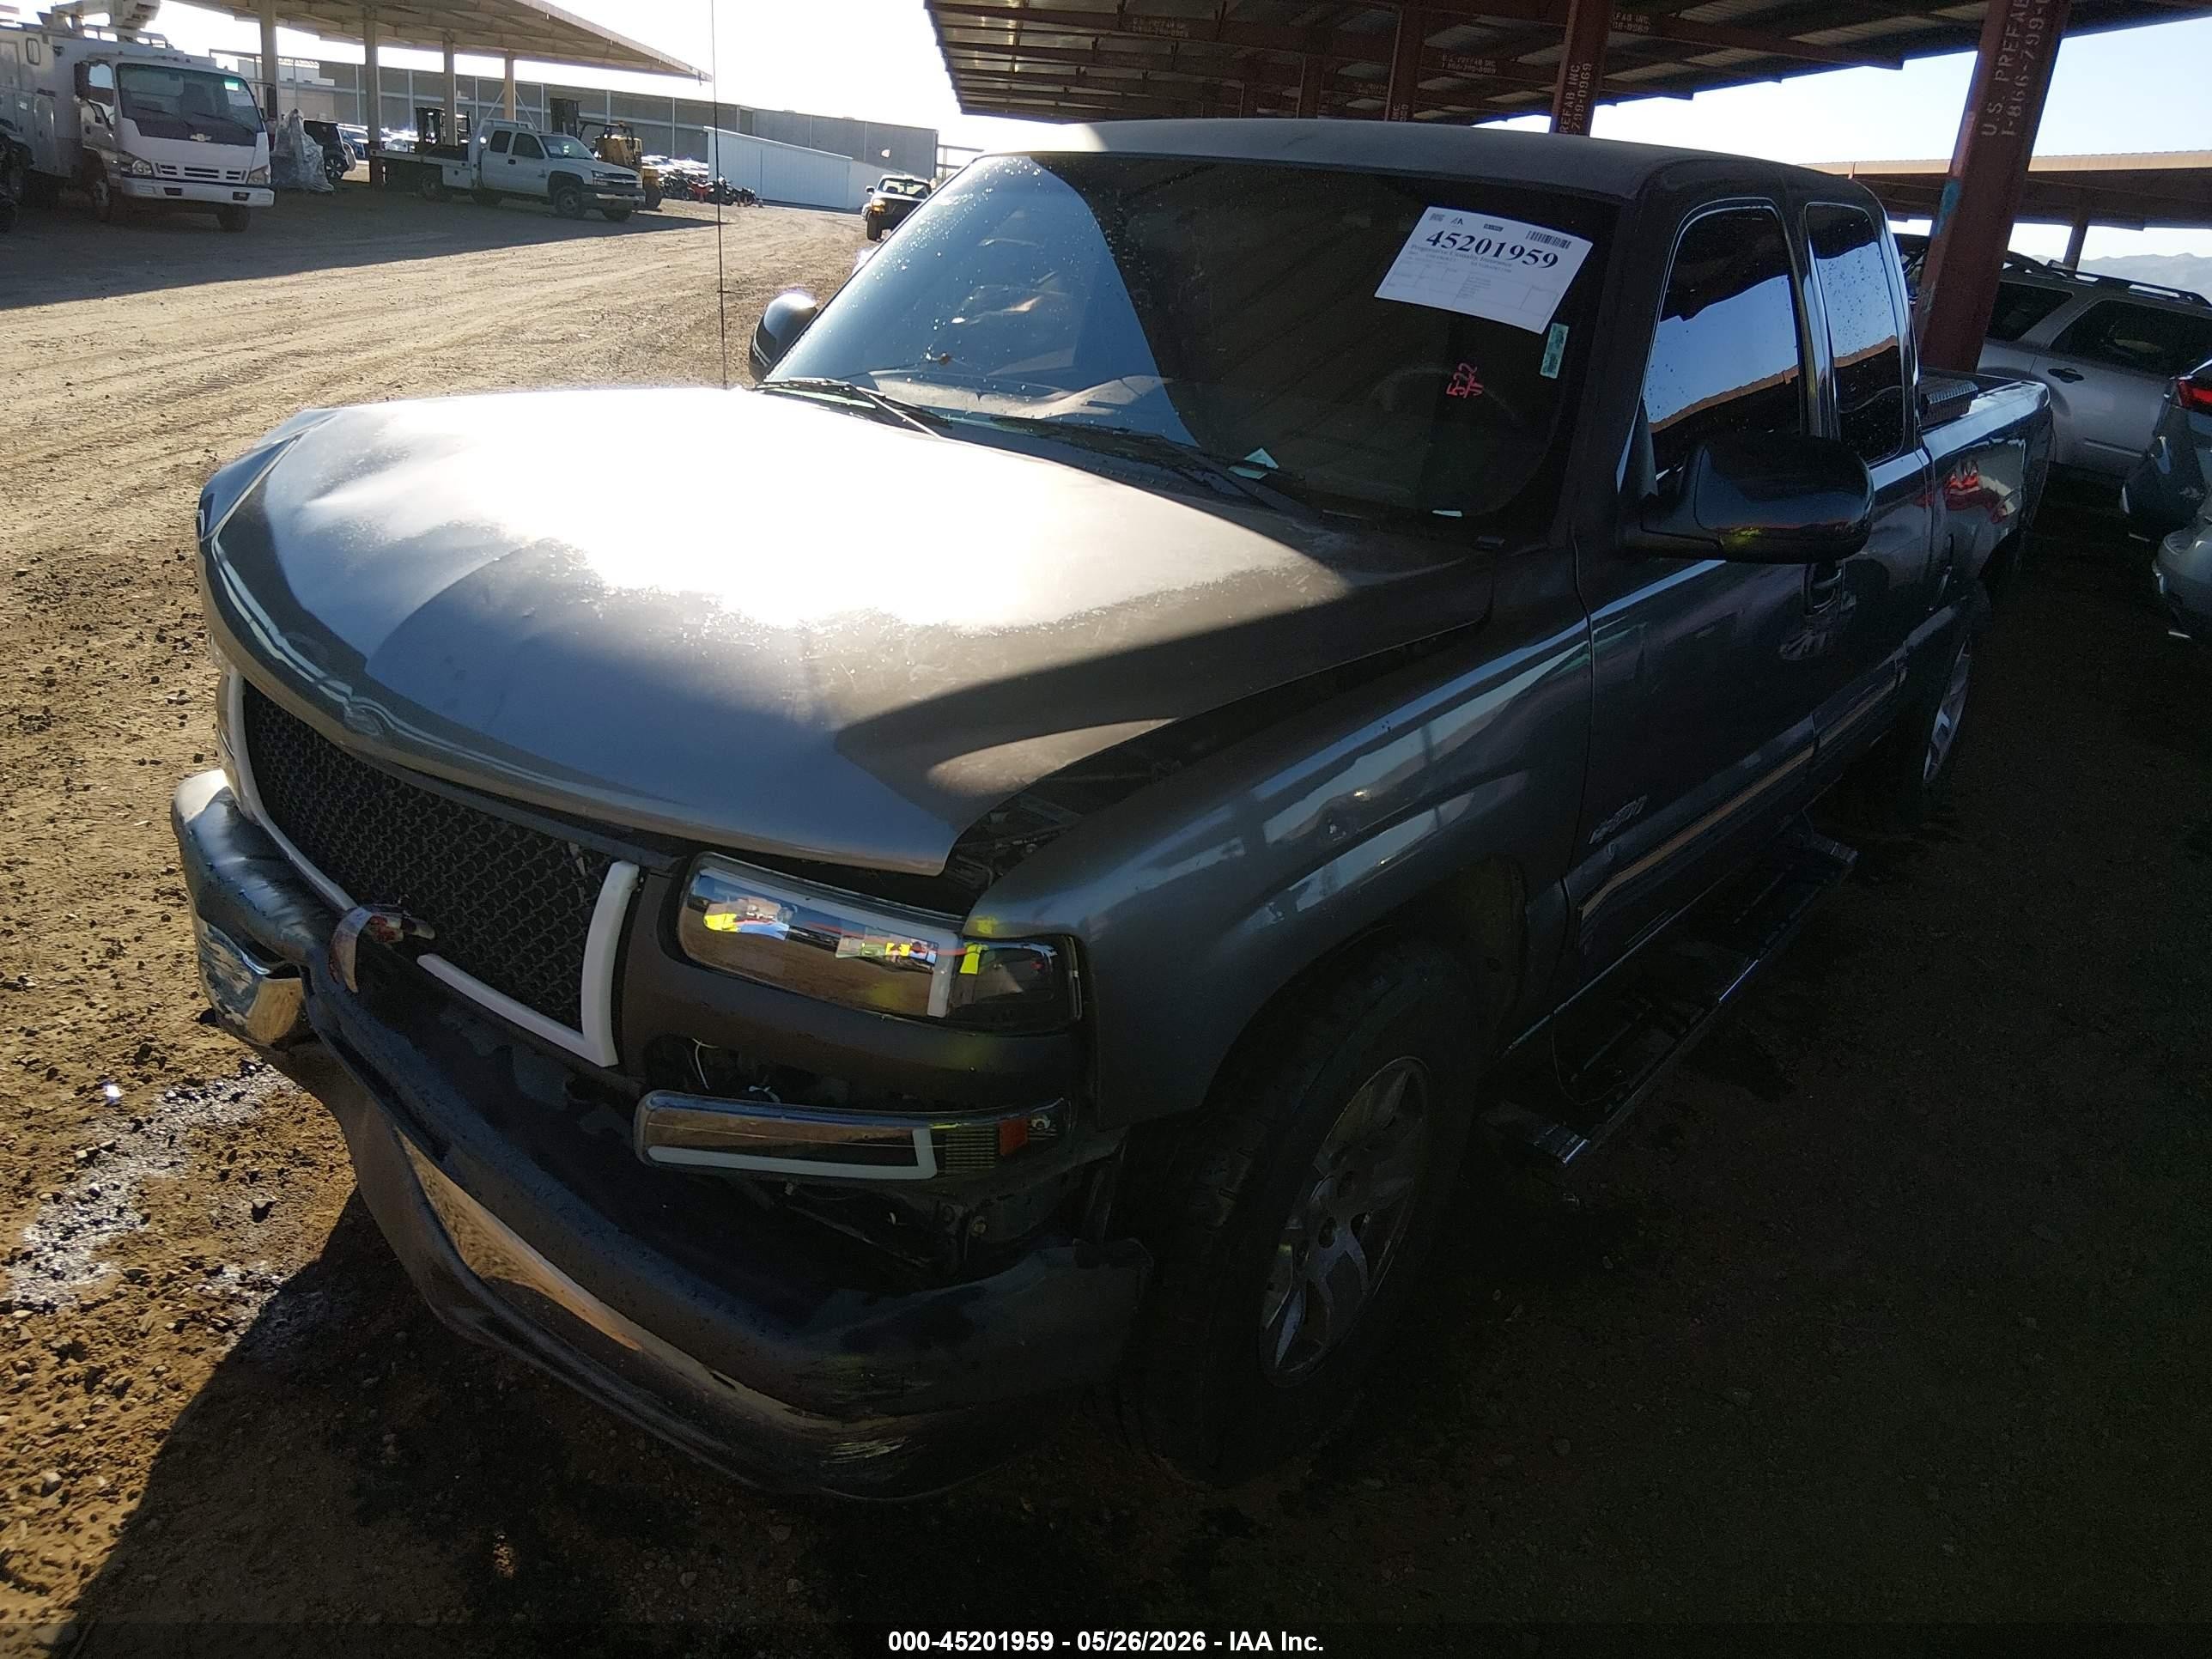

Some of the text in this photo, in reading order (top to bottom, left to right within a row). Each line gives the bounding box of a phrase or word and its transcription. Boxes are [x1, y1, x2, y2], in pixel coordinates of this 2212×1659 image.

[1559, 91, 1576, 133] REFAB
[1982, 96, 2006, 136] U.S.
[1425, 229, 1559, 269] 45201959
